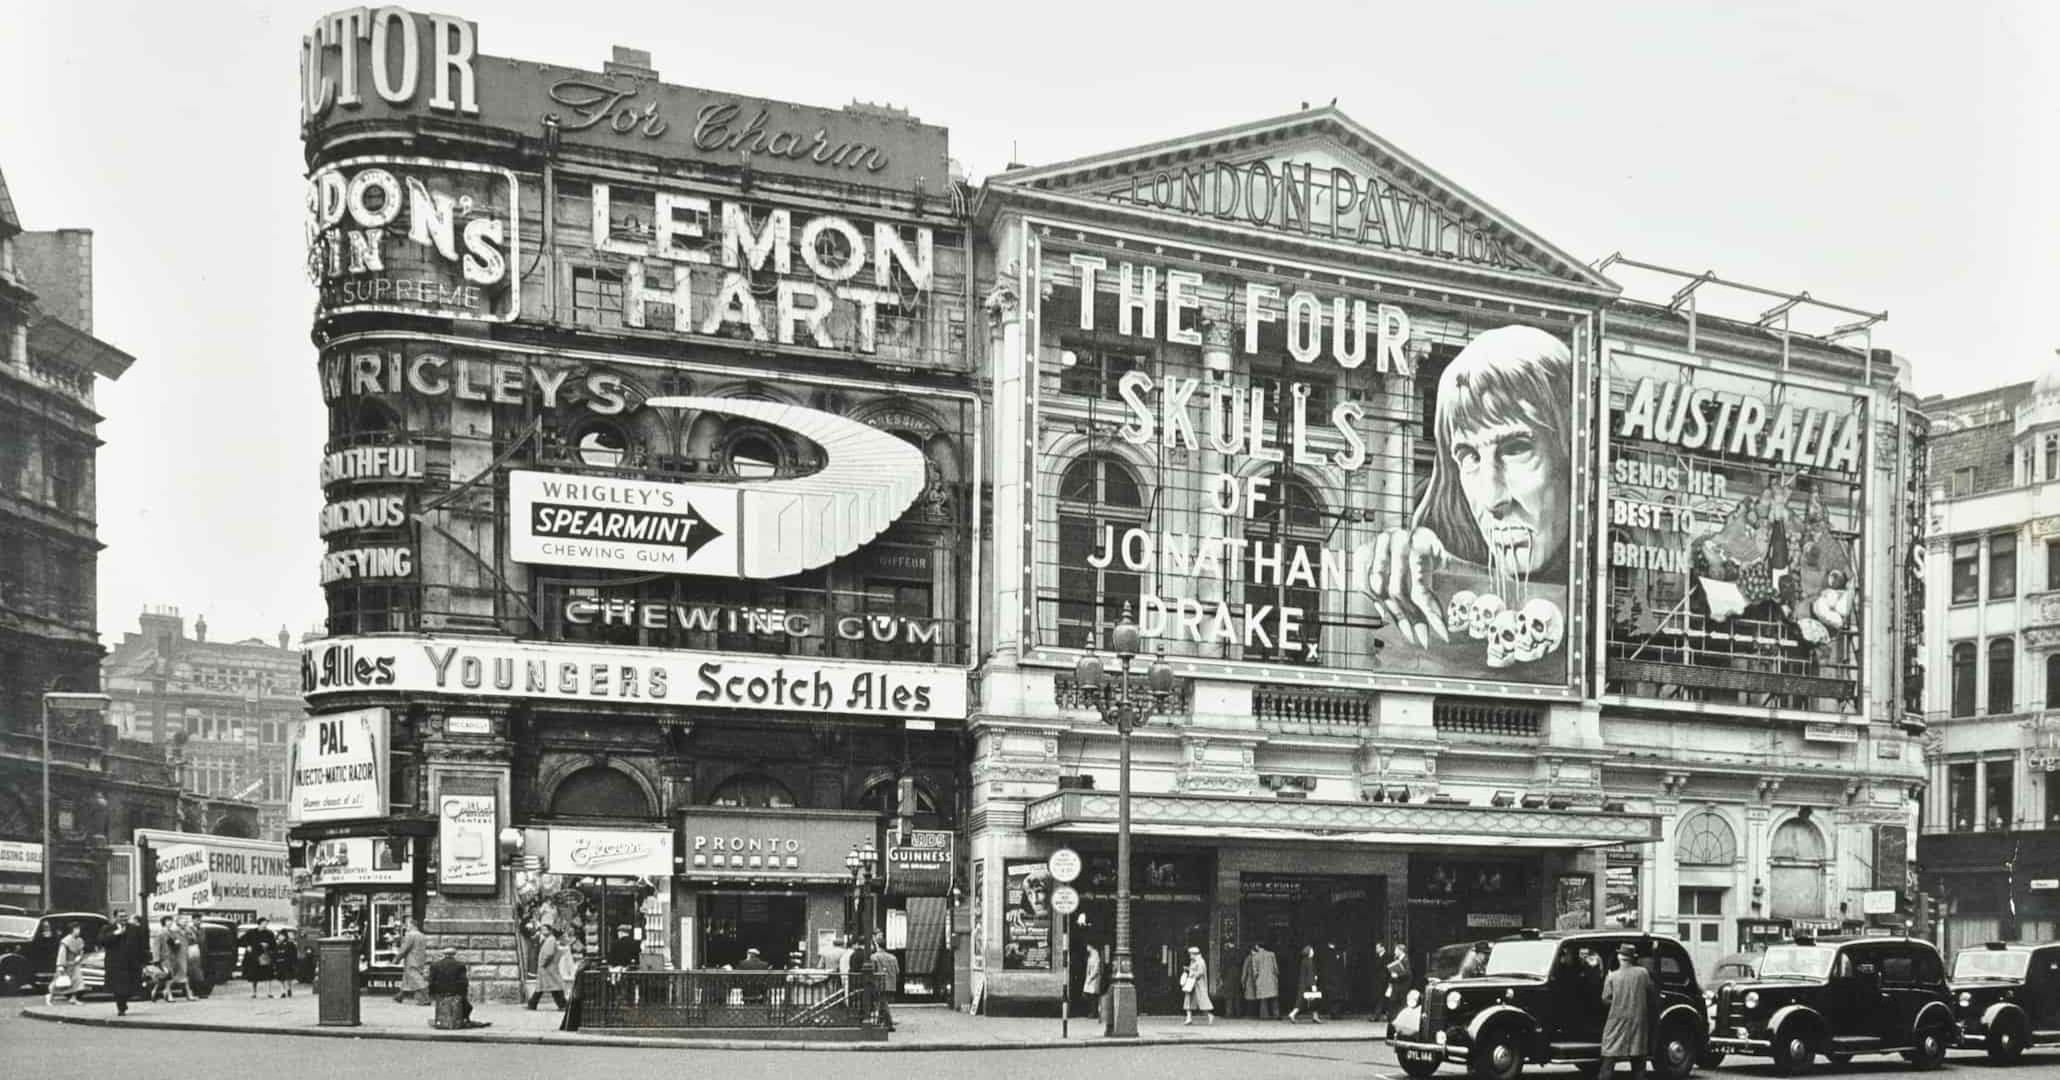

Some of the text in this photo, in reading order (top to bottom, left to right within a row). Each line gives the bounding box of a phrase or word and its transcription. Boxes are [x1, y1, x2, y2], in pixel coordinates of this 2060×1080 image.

[302, 6, 479, 116] CTOR
[549, 79, 888, 173] For Charm
[1131, 160, 1524, 271] LONDON PAVILION
[592, 183, 934, 290] LEMON
[343, 278, 480, 308] SUPREME
[627, 260, 899, 353] HART
[1070, 253, 1410, 376] THE FOUR
[1118, 370, 1366, 471] SKULLS
[1619, 375, 1862, 473] AUSTRALIA
[542, 481, 674, 508] WRIGLEY'S
[1615, 459, 1727, 497] SENDS HER
[1214, 473, 1271, 521] OF
[534, 508, 698, 544] SPEARMINT
[1613, 499, 1696, 535] BEST TO
[542, 543, 675, 563] CHEWING GUM
[1087, 524, 1348, 591] JONATHAN
[1612, 541, 1690, 574] BRITAIN
[566, 600, 942, 644] CHEWING GUM
[1139, 593, 1304, 653] DRAKE
[320, 645, 395, 686] Ales
[424, 646, 668, 699] YOUNGERS
[696, 662, 833, 709] Scotch
[847, 672, 932, 712] Ales
[320, 720, 349, 756] PAL
[348, 762, 374, 782] RAZOR
[695, 837, 800, 852] PRONTO
[889, 846, 951, 862] GUINNESS
[209, 852, 247, 875] ERROL
[153, 901, 176, 912] ONLY
[192, 889, 209, 906] FOR
[211, 880, 223, 902] My
[223, 882, 250, 899] wicked
[252, 886, 276, 900] wicked
